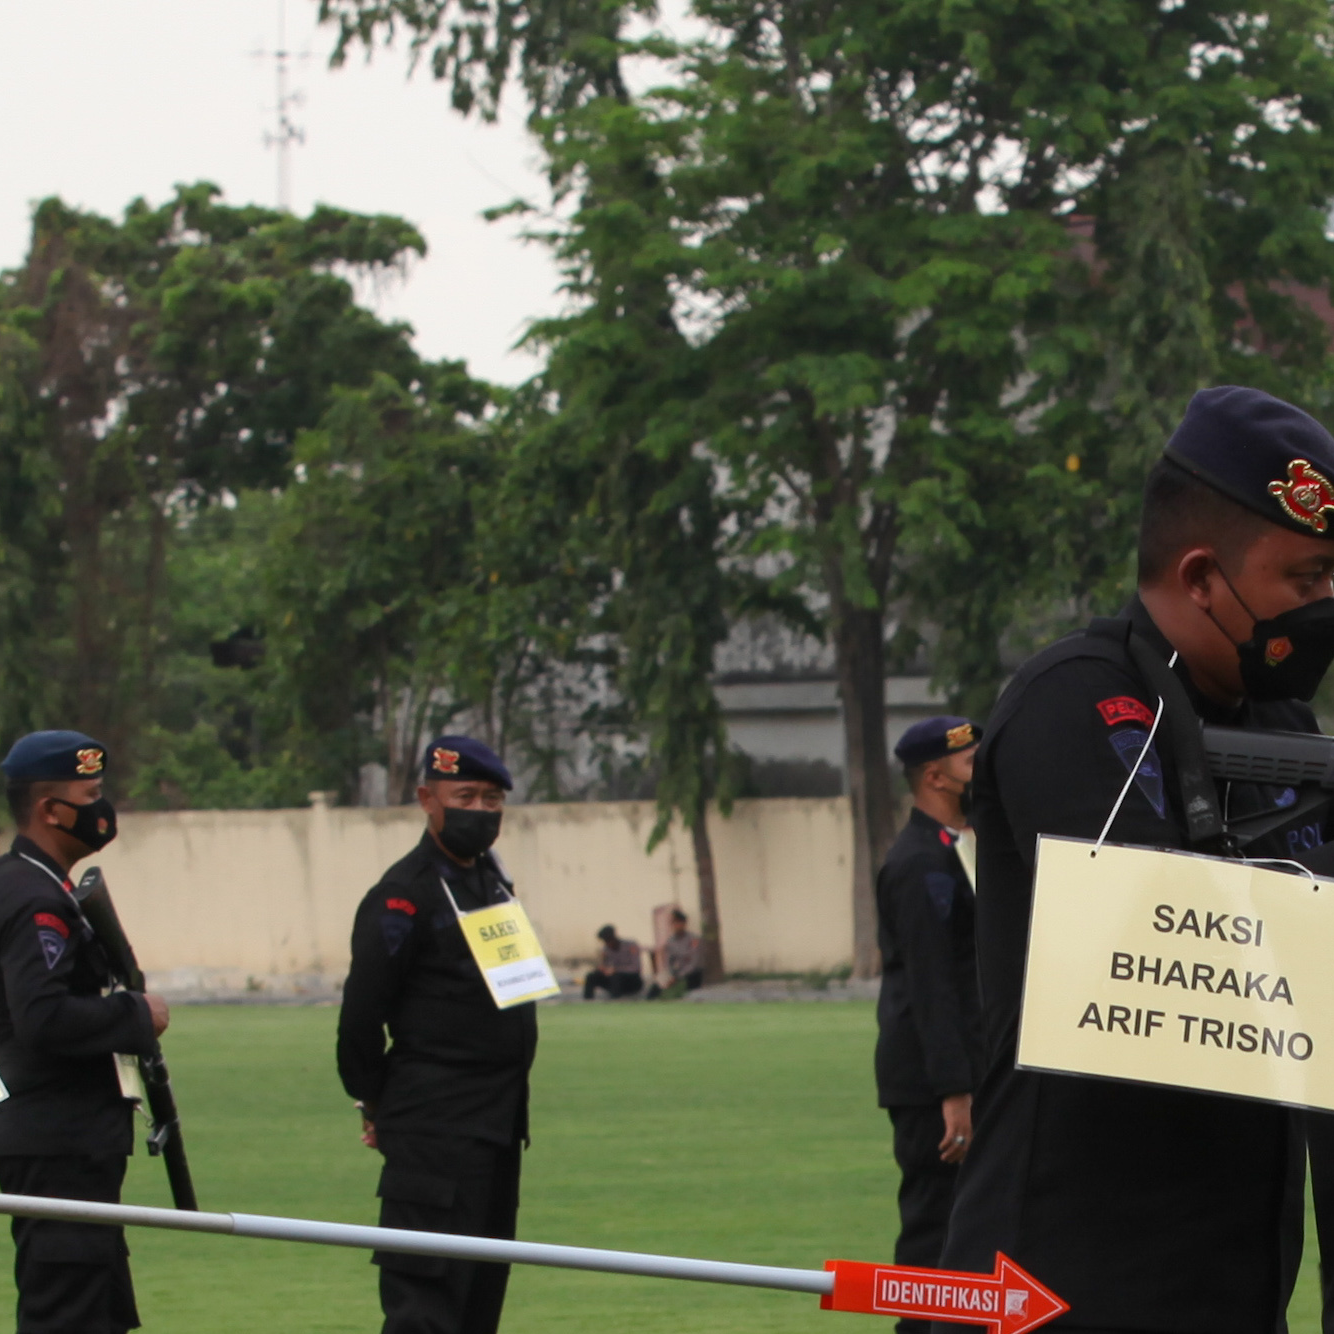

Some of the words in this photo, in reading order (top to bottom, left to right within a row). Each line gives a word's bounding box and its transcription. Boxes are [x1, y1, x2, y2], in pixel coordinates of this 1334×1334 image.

[479, 919, 520, 942] SAKSI
[1153, 904, 1263, 947] SAKSI
[1110, 951, 1294, 1006] BHARAKA
[1078, 1002, 1165, 1037] ARIF
[1178, 1014, 1313, 1061] TRISNO
[882, 1279, 999, 1313] IDENTIFIKASI
